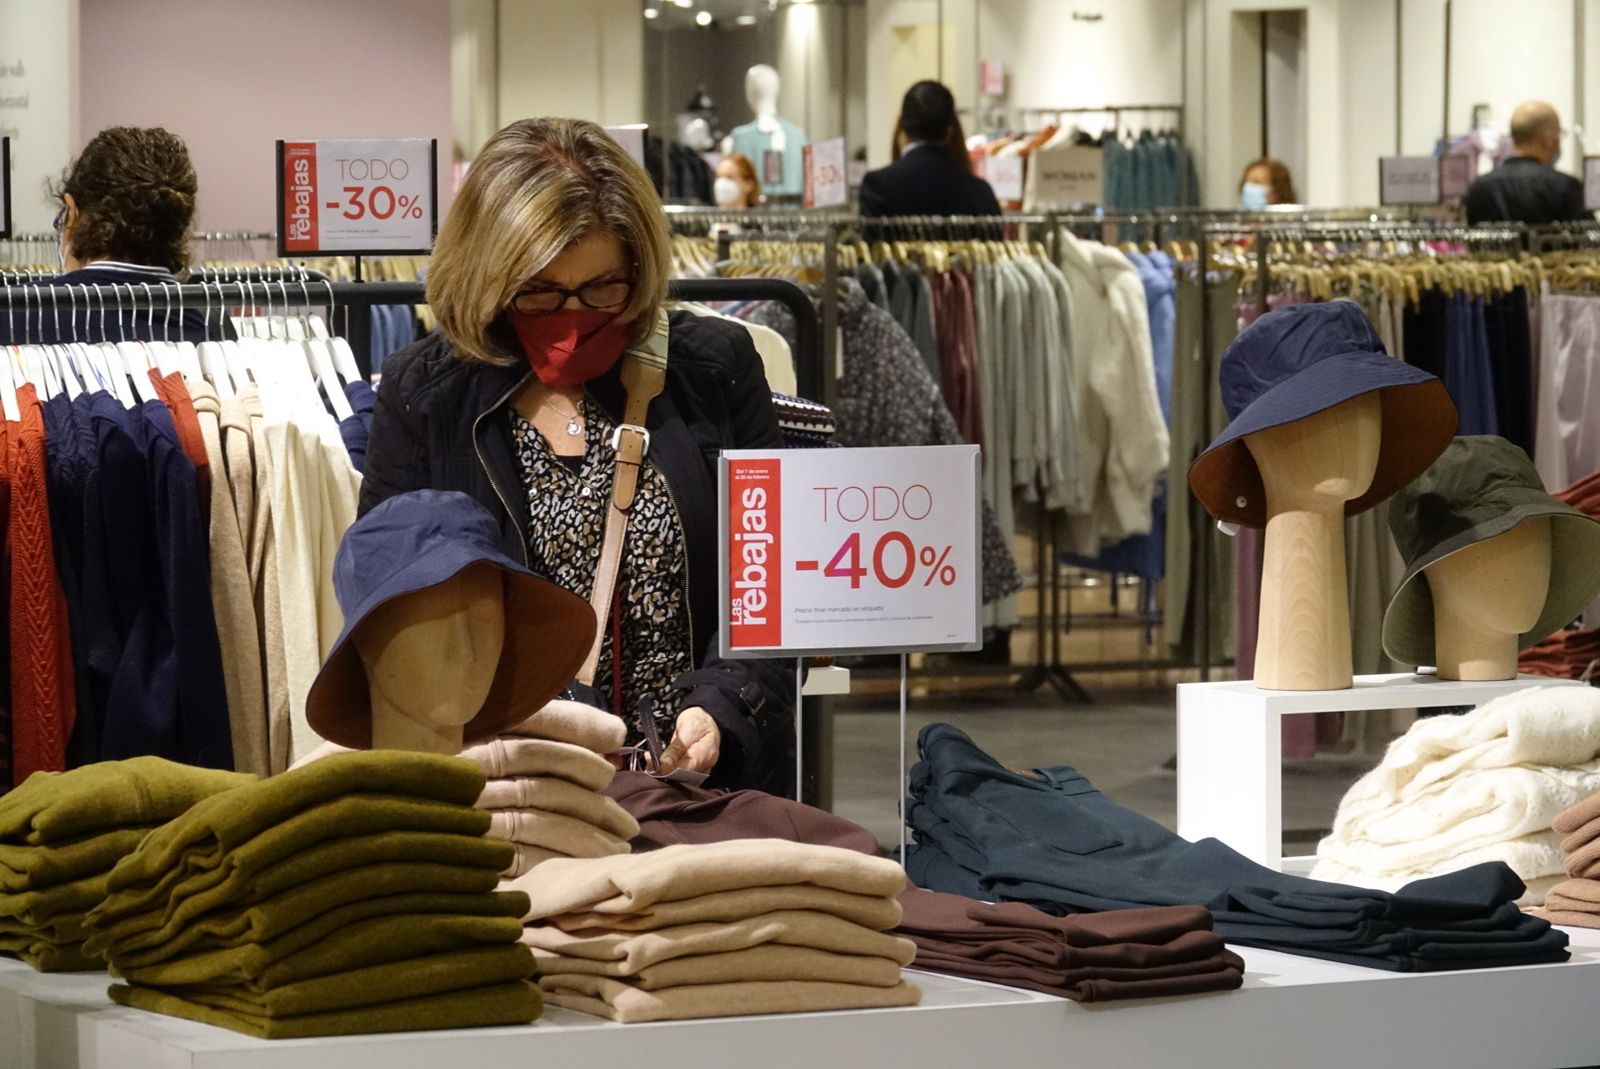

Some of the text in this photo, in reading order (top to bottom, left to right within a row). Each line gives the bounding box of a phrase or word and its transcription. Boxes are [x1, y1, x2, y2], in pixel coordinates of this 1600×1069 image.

[335, 158, 409, 181] TODO
[291, 159, 314, 240] rebajas
[325, 186, 423, 220] -30%
[288, 223, 297, 241] Las
[812, 484, 932, 523] TODO
[735, 487, 774, 625] rebajas
[795, 530, 957, 589] -40%
[730, 598, 742, 625] Las
